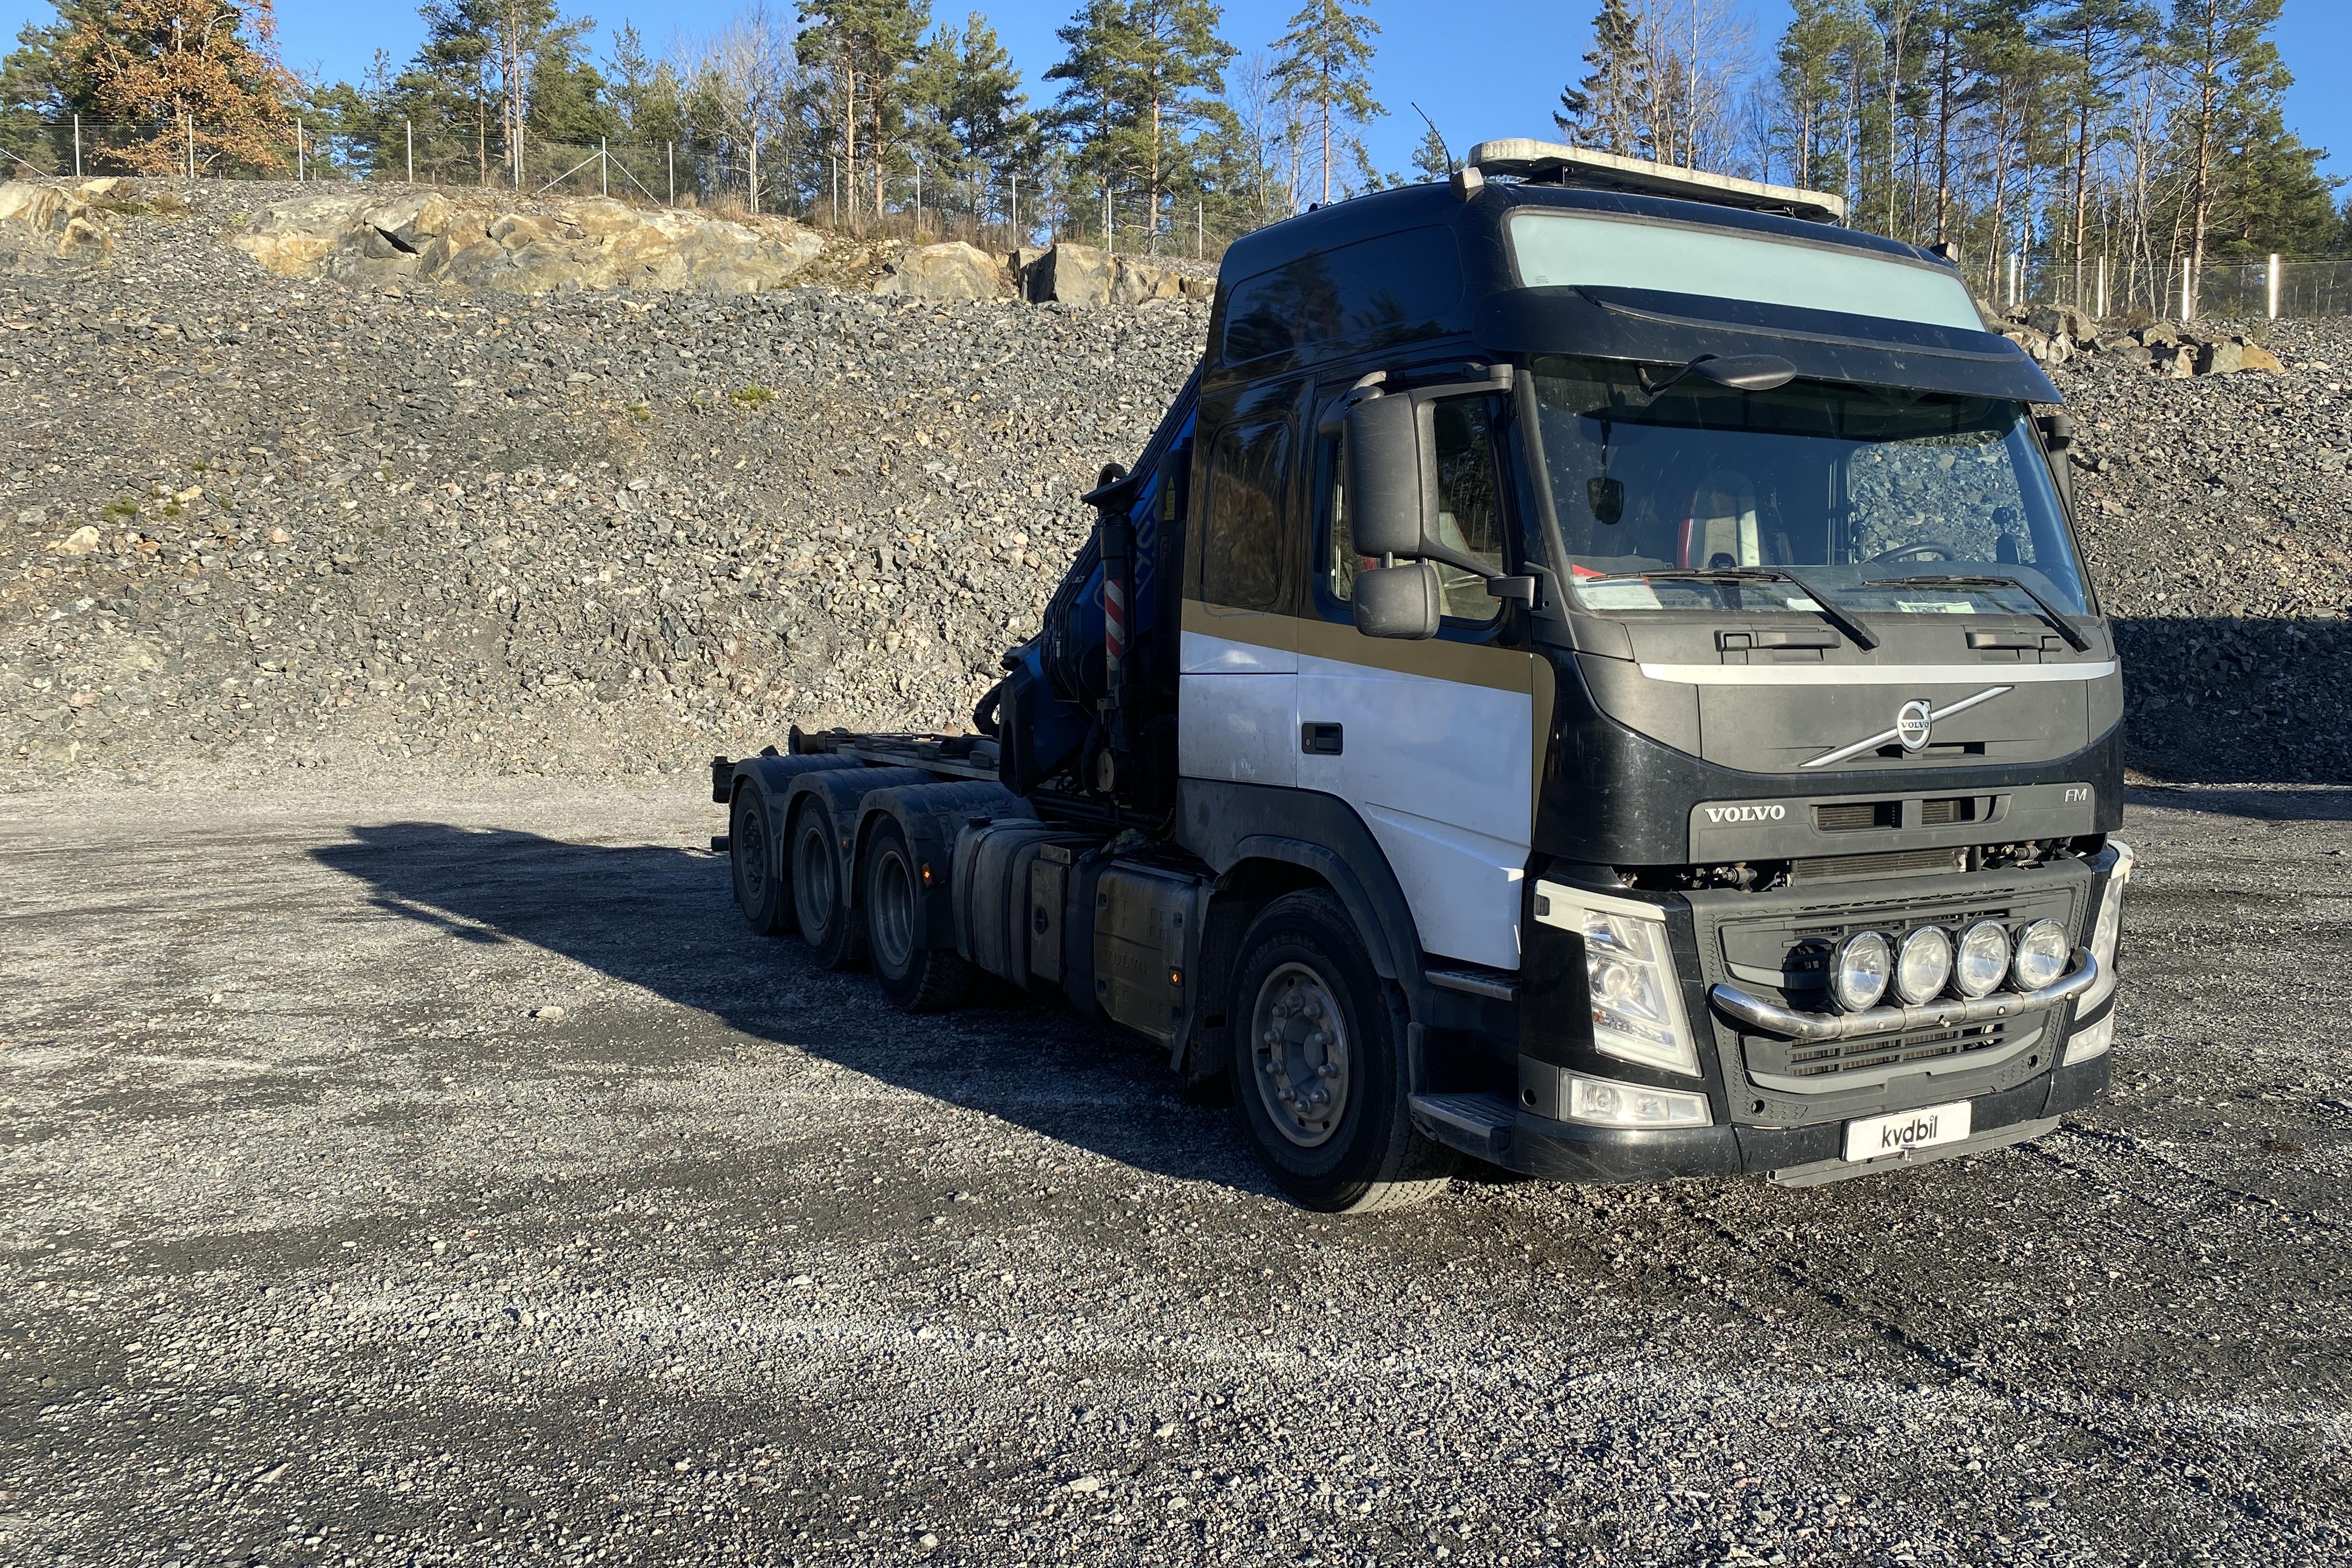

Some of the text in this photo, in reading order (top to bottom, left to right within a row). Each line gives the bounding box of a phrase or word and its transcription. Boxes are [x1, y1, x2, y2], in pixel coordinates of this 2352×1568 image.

[2065, 788, 2087, 802] FM
[1704, 804, 1786, 823] VOLVO
[1104, 950, 1148, 975] VOLVO
[1882, 1115, 1938, 1148] kvdbil
